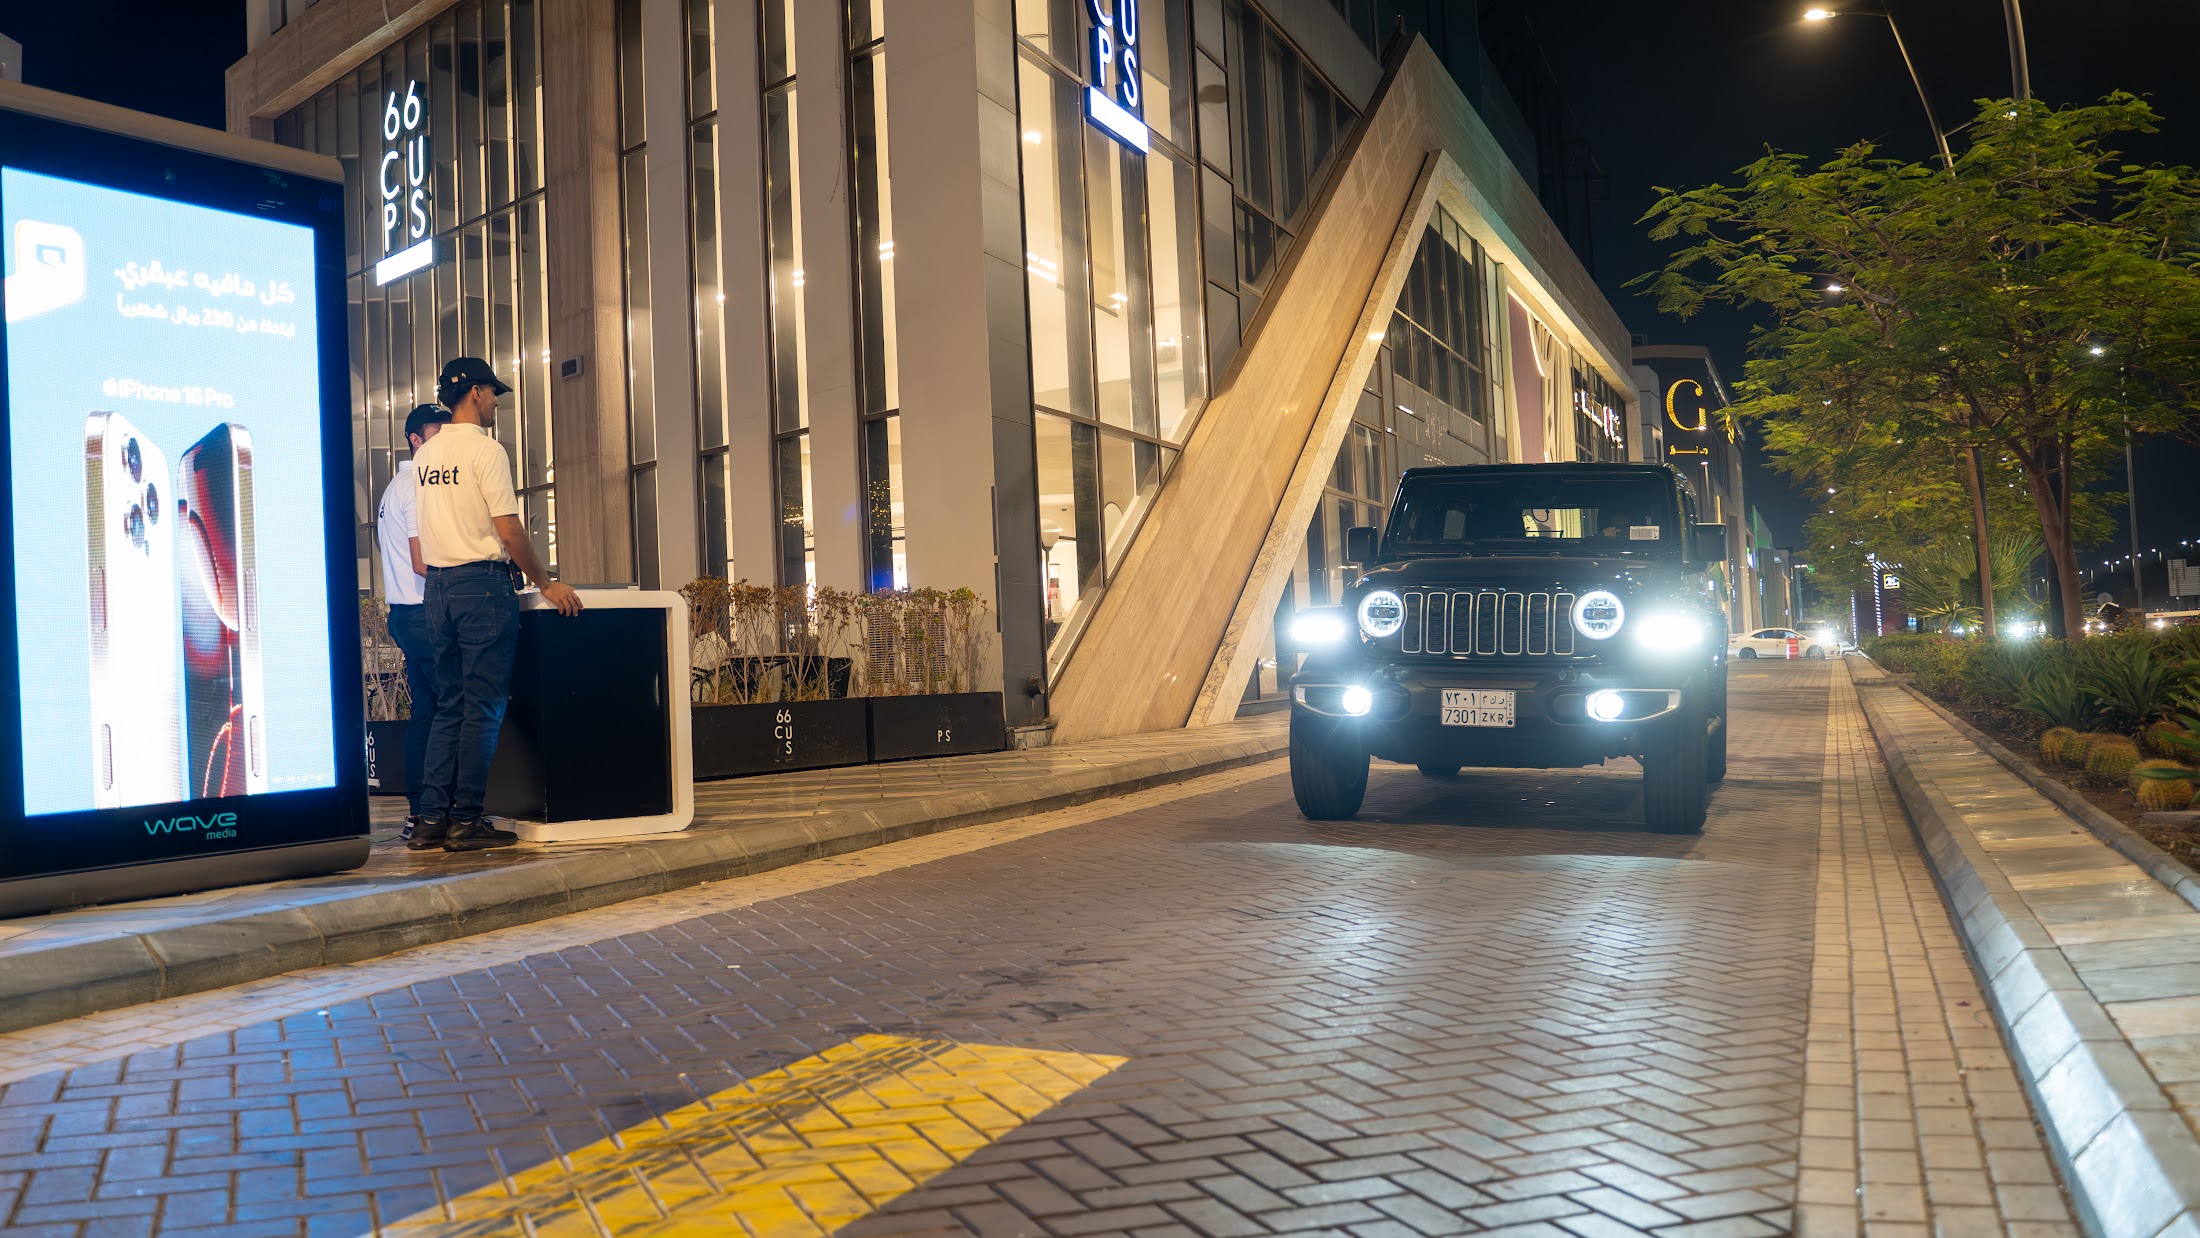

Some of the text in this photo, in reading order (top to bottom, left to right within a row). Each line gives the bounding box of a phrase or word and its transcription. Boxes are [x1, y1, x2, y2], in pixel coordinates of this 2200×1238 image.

[384, 79, 421, 141] 66
[259, 279, 296, 306] كل
[170, 305, 201, 327] ريال
[202, 307, 234, 328] 230
[236, 316, 258, 333] من
[204, 386, 235, 408] Pro
[776, 708, 792, 724] 66
[1445, 709, 1505, 724] 7301 ZKR
[144, 811, 237, 836] wave
[206, 828, 237, 840] media
